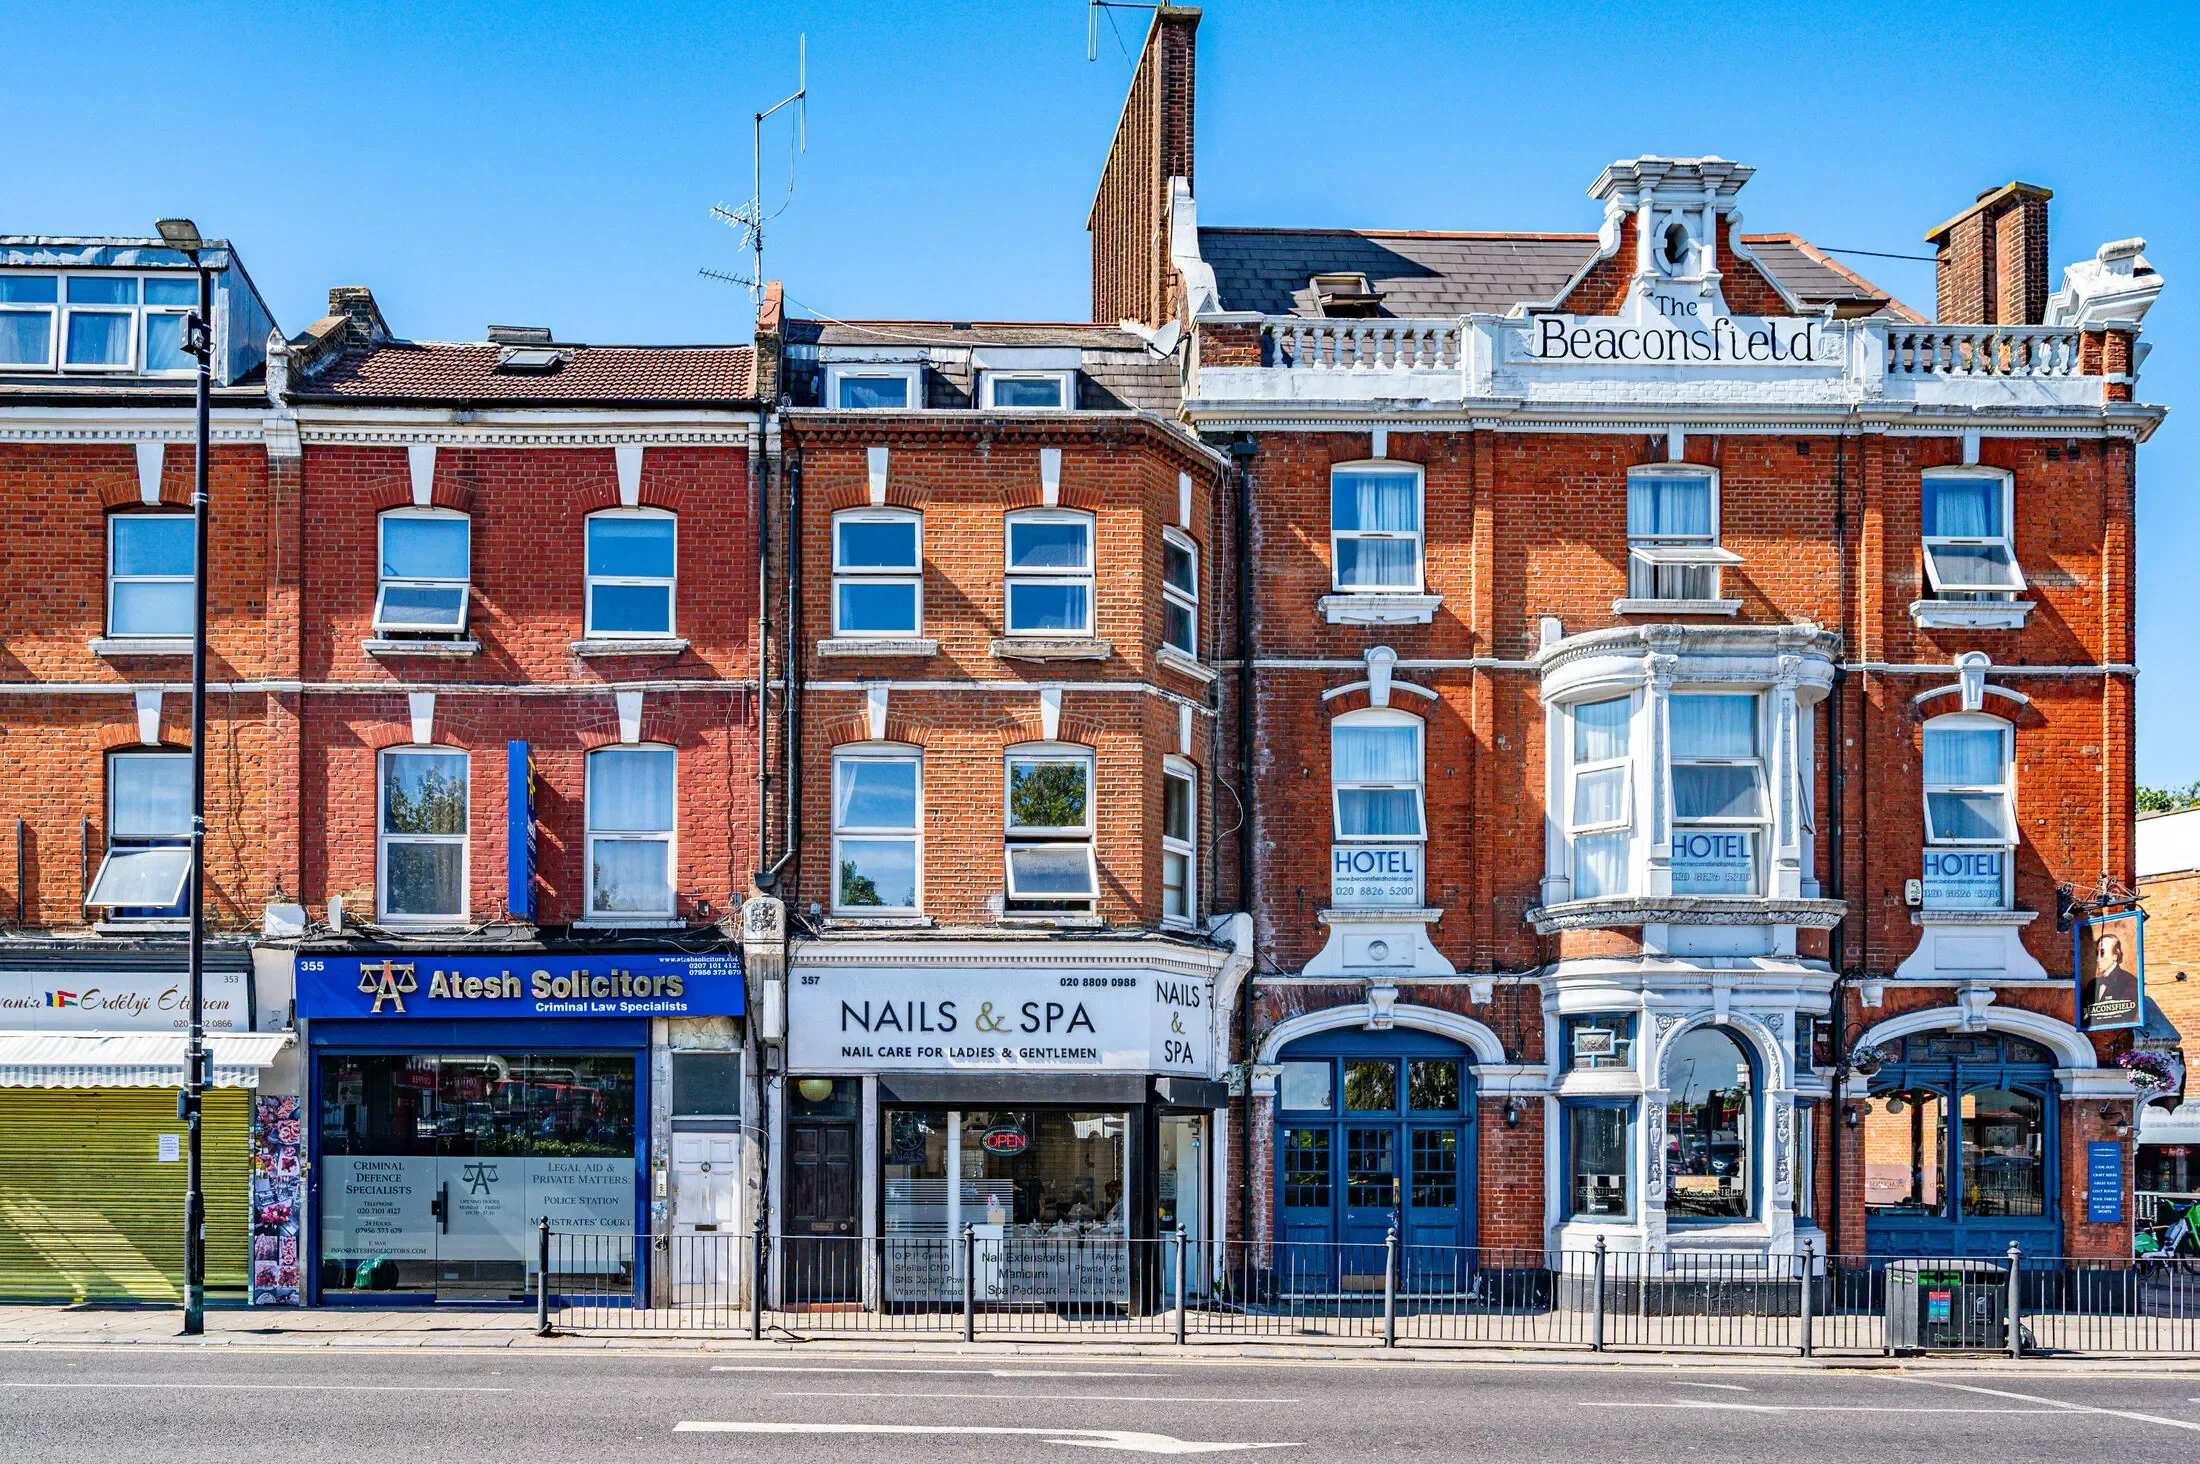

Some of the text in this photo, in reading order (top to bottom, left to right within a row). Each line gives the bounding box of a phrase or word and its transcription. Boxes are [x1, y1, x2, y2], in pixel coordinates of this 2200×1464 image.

[1655, 295, 1698, 316] The
[1538, 317, 1816, 361] Beaconsfield
[1672, 835, 1751, 858] HOTEL
[1336, 851, 1413, 873] HOTEL
[1924, 854, 2000, 876] HOTEL
[1672, 872, 1690, 881] 020
[1336, 887, 1414, 896] 020 8826 5200
[300, 961, 325, 971] 355
[224, 975, 239, 983] 353
[428, 969, 685, 999] Atesh Solicitors
[801, 976, 820, 985] 357
[1060, 977, 1136, 987] 020 8809 0988
[1155, 979, 1200, 1008] NAILS
[80, 988, 151, 1017] Erdélyi
[158, 984, 231, 1011] Étrem
[535, 1002, 688, 1014] Criminal Law Specialists
[842, 1000, 1096, 1033] NAILS & SPA
[173, 1020, 189, 1028] 020
[212, 1020, 233, 1028] 0866
[1171, 1011, 1186, 1035] &
[842, 1047, 1097, 1059] NAIL CARE FOR LADIES & GENTLEMEN
[1164, 1040, 1194, 1065] SPA
[987, 1133, 1026, 1148] OPEN
[353, 1161, 405, 1171] CRIMINAL
[548, 1162, 615, 1172] LEGAL AID &
[356, 1173, 402, 1182] DEFENCE
[532, 1174, 575, 1184] PRIVATE
[346, 1185, 412, 1195] SPECIALISTS
[544, 1196, 619, 1205] POLICE STATION
[530, 1217, 631, 1226] MISTRATES' COURT
[982, 1253, 1066, 1263] Nal Exensions
[1095, 1253, 1125, 1262] Acryic
[930, 1264, 950, 1272] CND
[1074, 1264, 1106, 1273] Powde
[946, 1276, 976, 1284] Powr
[988, 1284, 1009, 1296] Spa
[1069, 1288, 1088, 1296] Pik
[1100, 1288, 1125, 1296] Whte
